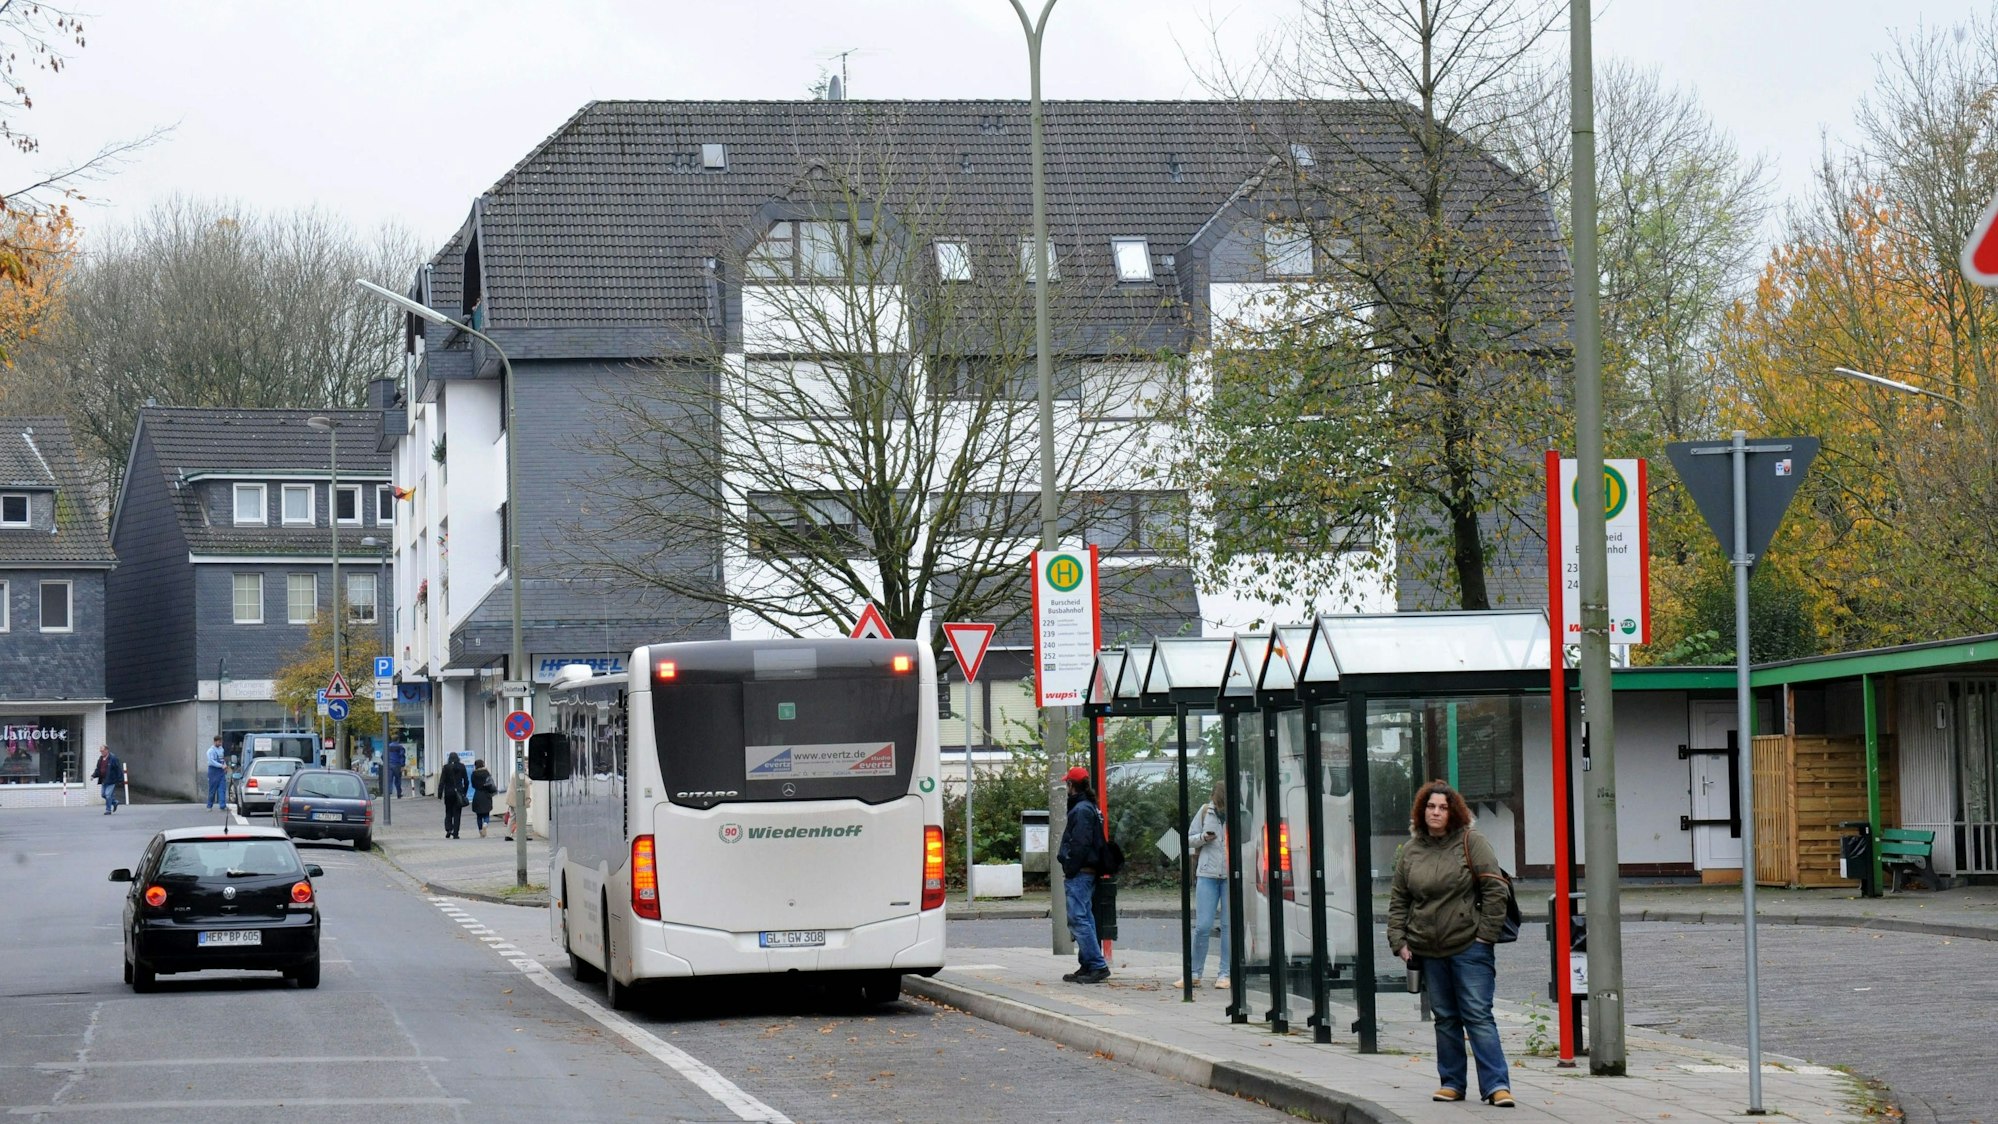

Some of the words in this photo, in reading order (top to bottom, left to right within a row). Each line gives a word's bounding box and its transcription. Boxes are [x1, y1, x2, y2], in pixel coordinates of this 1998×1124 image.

[1567, 563, 1579, 573] 23
[1057, 563, 1072, 584] H
[1567, 580, 1579, 589] 24
[1047, 607, 1084, 615] Busbahnhof
[378, 660, 389, 675] P
[1045, 689, 1078, 700] wupsi
[0, 725, 68, 741] lamotte
[793, 750, 866, 760] www.evertz.de
[859, 761, 892, 769] evertz
[676, 790, 739, 798] CITARO
[725, 827, 737, 836] 90
[748, 825, 864, 839] Wiedenhoff
[206, 933, 223, 942] HER
[229, 932, 241, 941] BP
[242, 932, 259, 941] 605
[766, 933, 780, 944] GL
[787, 933, 801, 943] GW
[804, 932, 824, 943] 308
